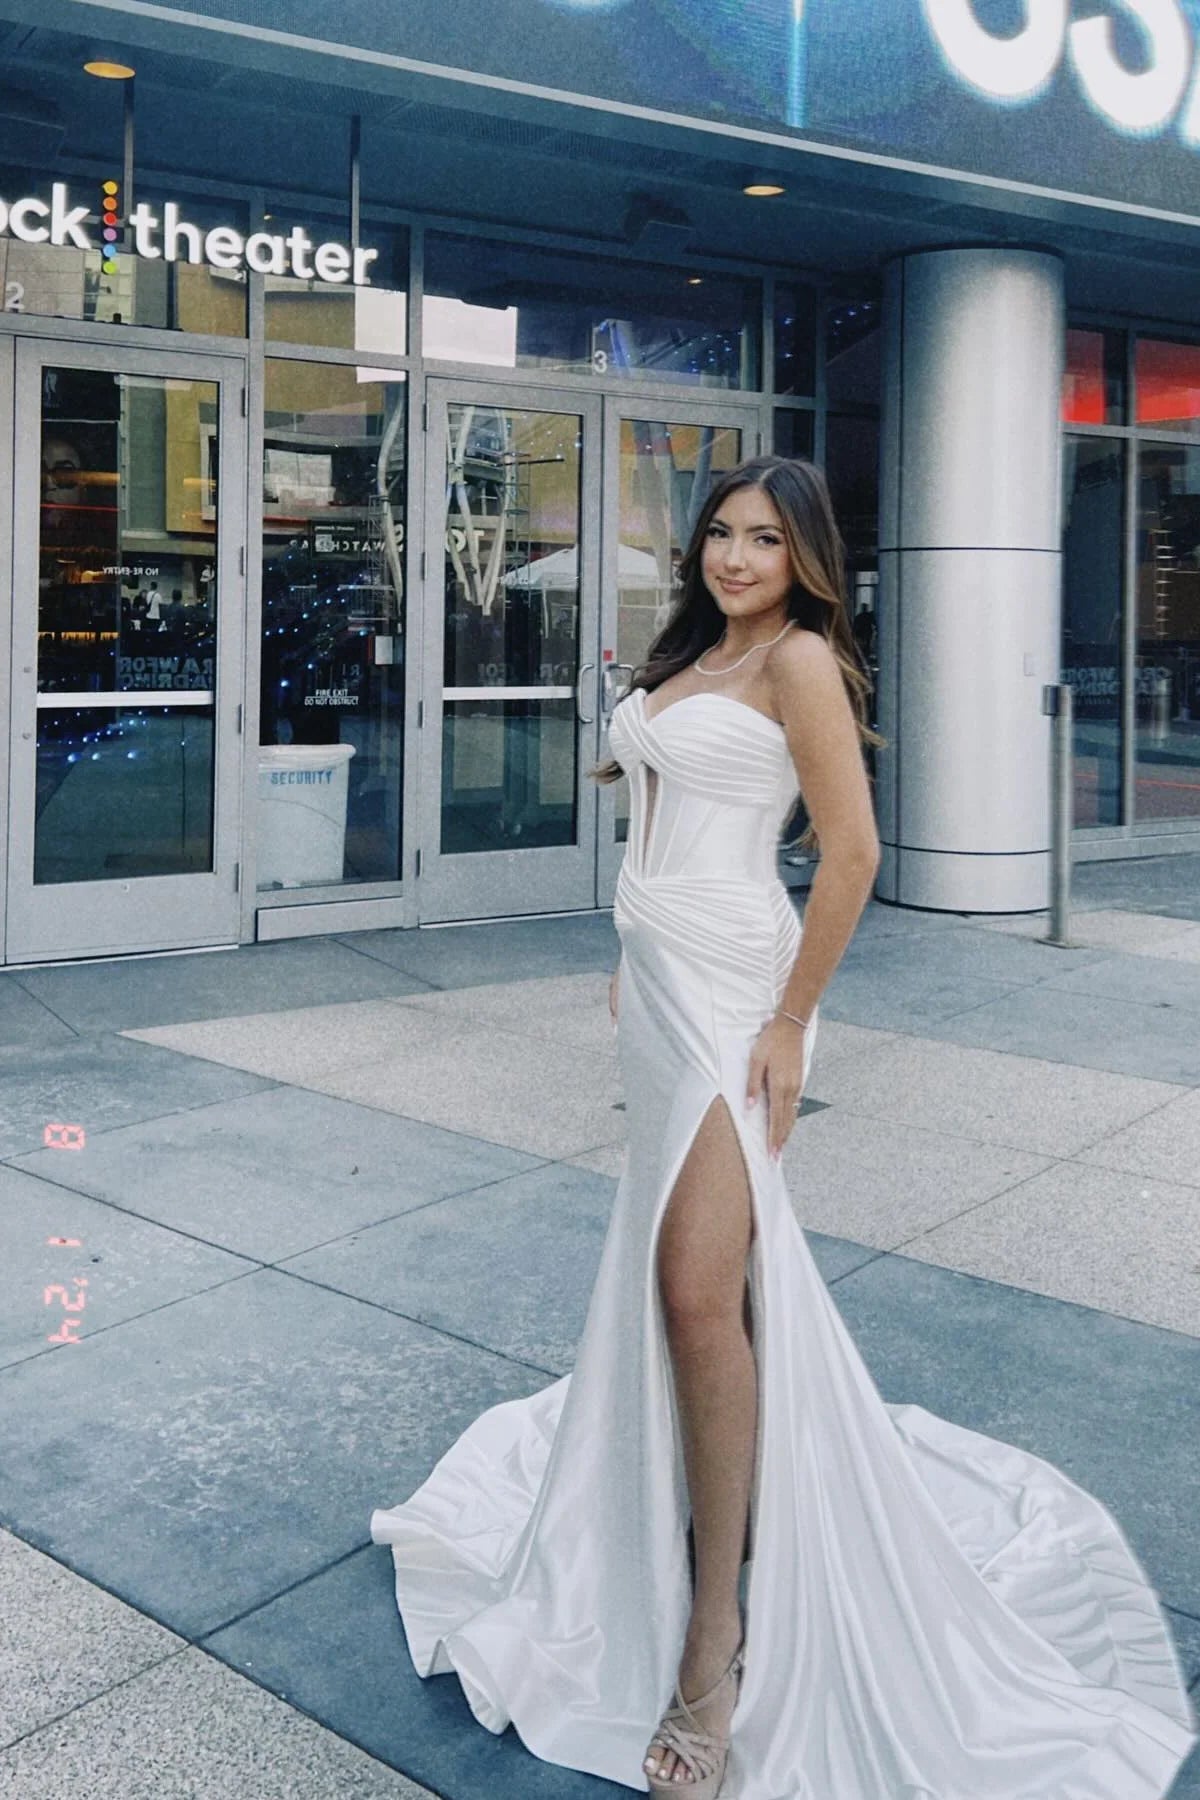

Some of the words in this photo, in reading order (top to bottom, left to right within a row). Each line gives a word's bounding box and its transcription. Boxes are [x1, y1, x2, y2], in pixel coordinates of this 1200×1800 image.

[0, 182, 92, 249] ck
[129, 202, 379, 285] theater
[5, 281, 25, 310] 2
[593, 350, 608, 374] 3
[304, 697, 314, 706] DO
[315, 688, 331, 697] FIRE
[332, 688, 348, 697] EXIT
[270, 769, 333, 785] SECURITY
